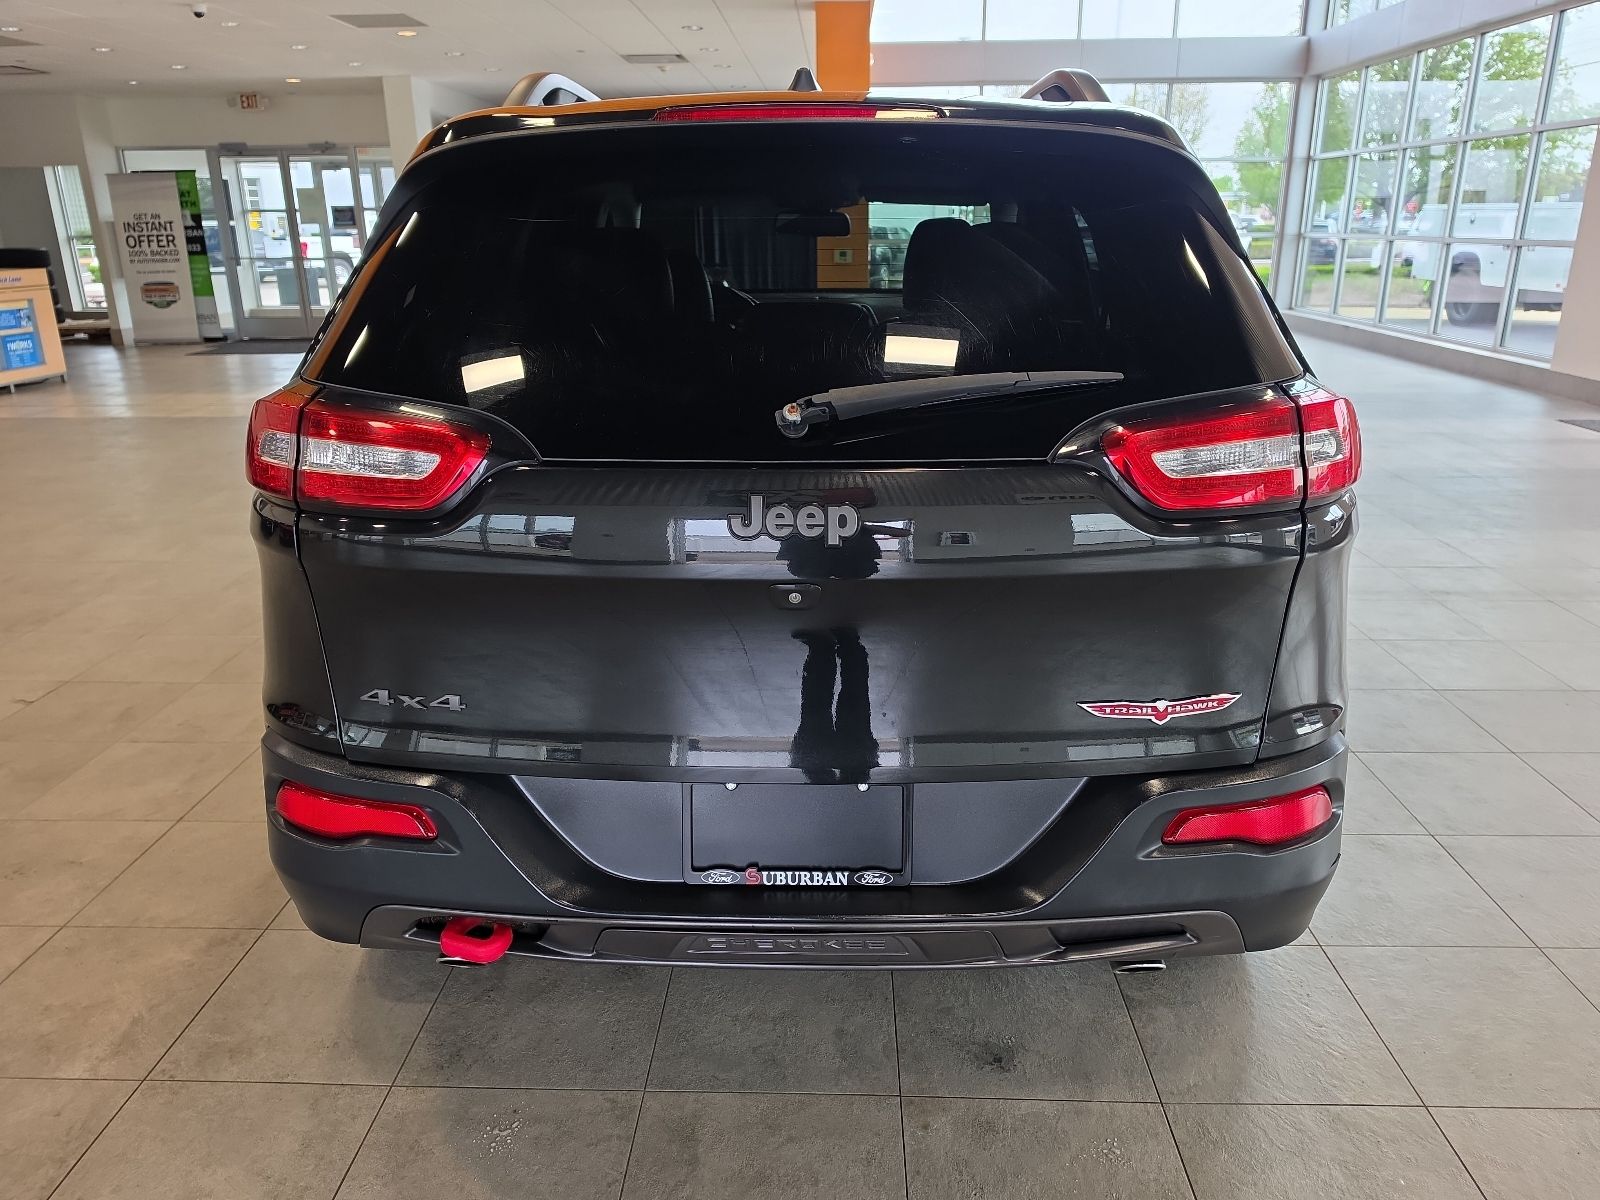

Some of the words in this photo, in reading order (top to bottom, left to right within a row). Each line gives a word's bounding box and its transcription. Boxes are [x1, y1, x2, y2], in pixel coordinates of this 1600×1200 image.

[240, 94, 258, 109] EXIT
[150, 212, 161, 220] AN
[123, 220, 174, 233] INSTANT
[126, 234, 177, 249] OFFER
[150, 248, 180, 257] BACKED
[729, 494, 859, 547] Jeep
[360, 688, 467, 711] 4x4
[745, 867, 849, 886] SUBURBAN
[707, 937, 887, 950] CHEROKEE
